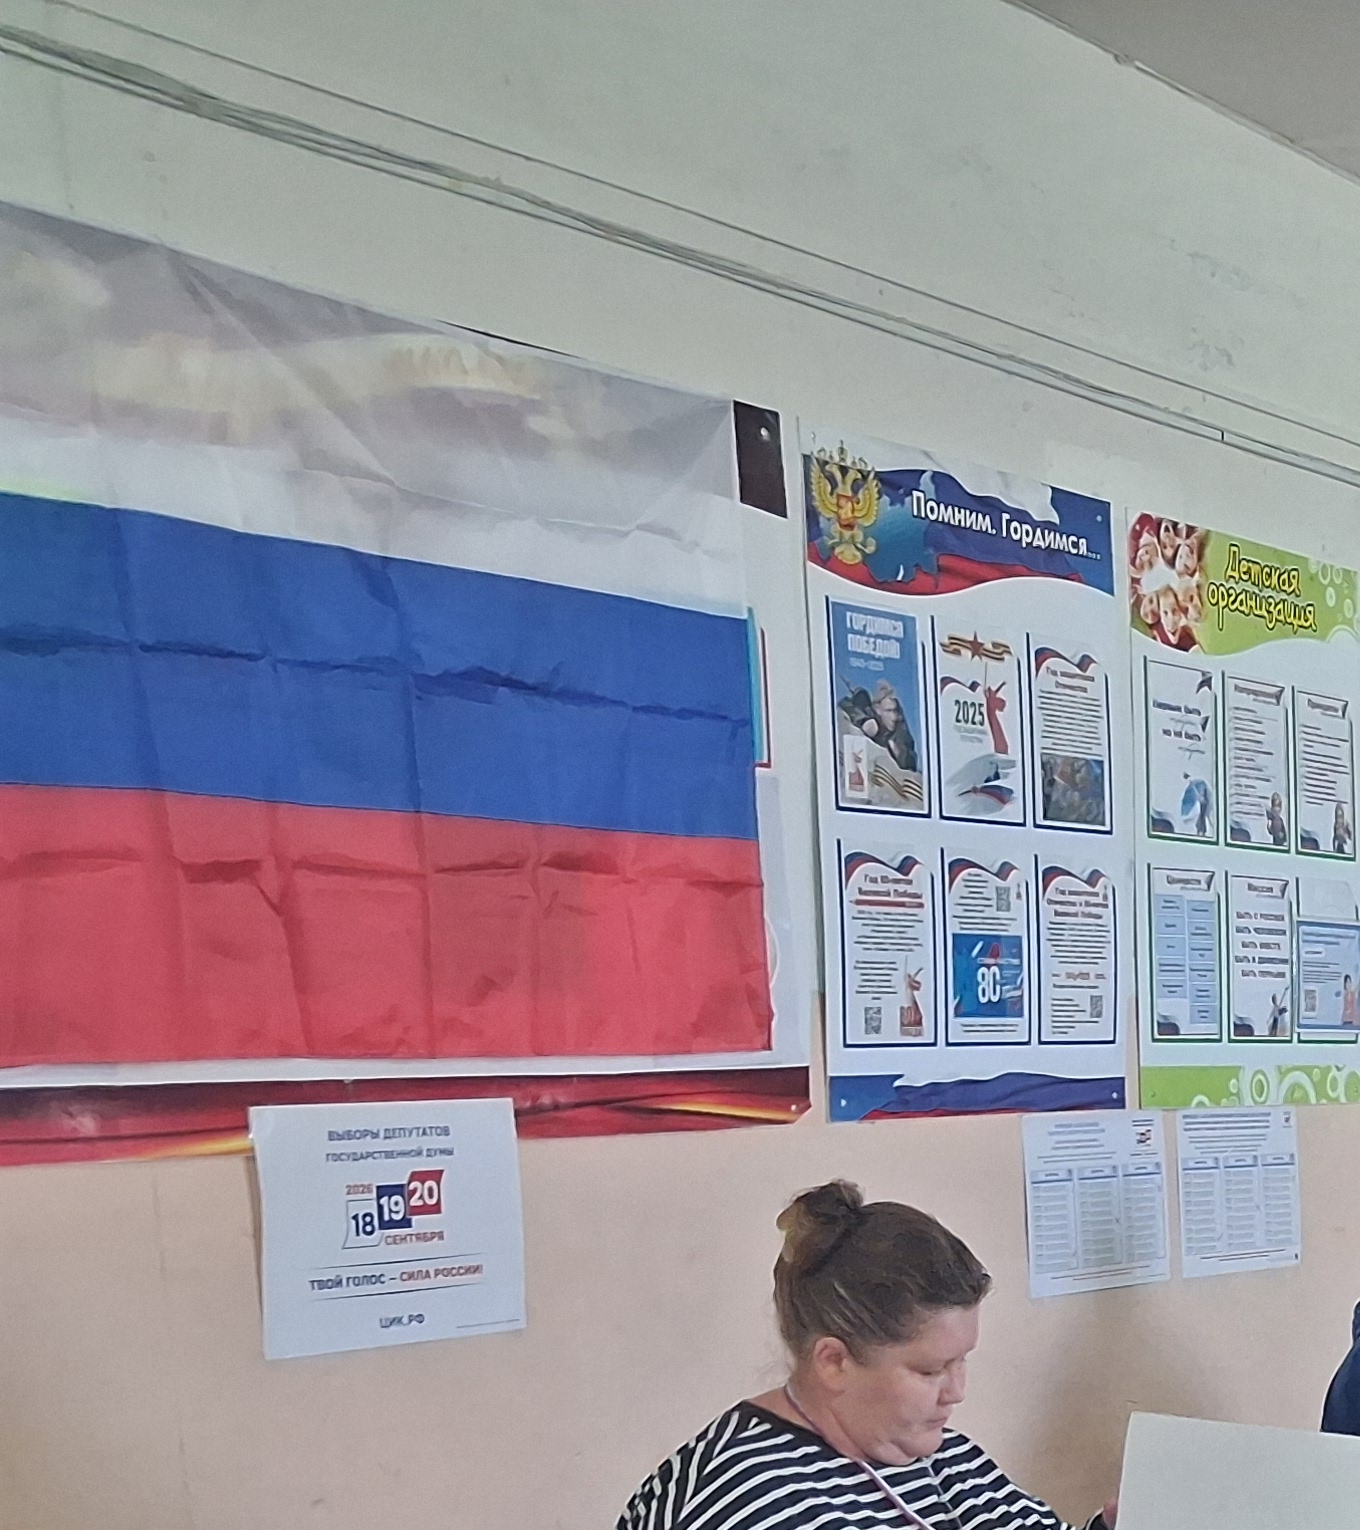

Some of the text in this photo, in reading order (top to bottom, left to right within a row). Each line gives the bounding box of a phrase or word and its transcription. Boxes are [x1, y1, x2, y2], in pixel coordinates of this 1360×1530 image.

[912, 489, 997, 535] Помним.
[1225, 543, 1301, 598] Детская
[1207, 582, 1318, 635] организация
[954, 699, 985, 727] 2025
[977, 966, 1001, 1004] 80
[327, 1125, 451, 1142] ВЫБОРЫ ДЕПУТАТОВ
[325, 1147, 455, 1163] ГОСУДАРСТВЕННОЙ ДУМЫ
[350, 1180, 440, 1238] 18 19 20
[384, 1230, 445, 1246] СЕНТЯБРЯ
[308, 1275, 343, 1291] ТВОЙ
[345, 1273, 386, 1288] ГОЛОС
[399, 1268, 431, 1282] СИЛА
